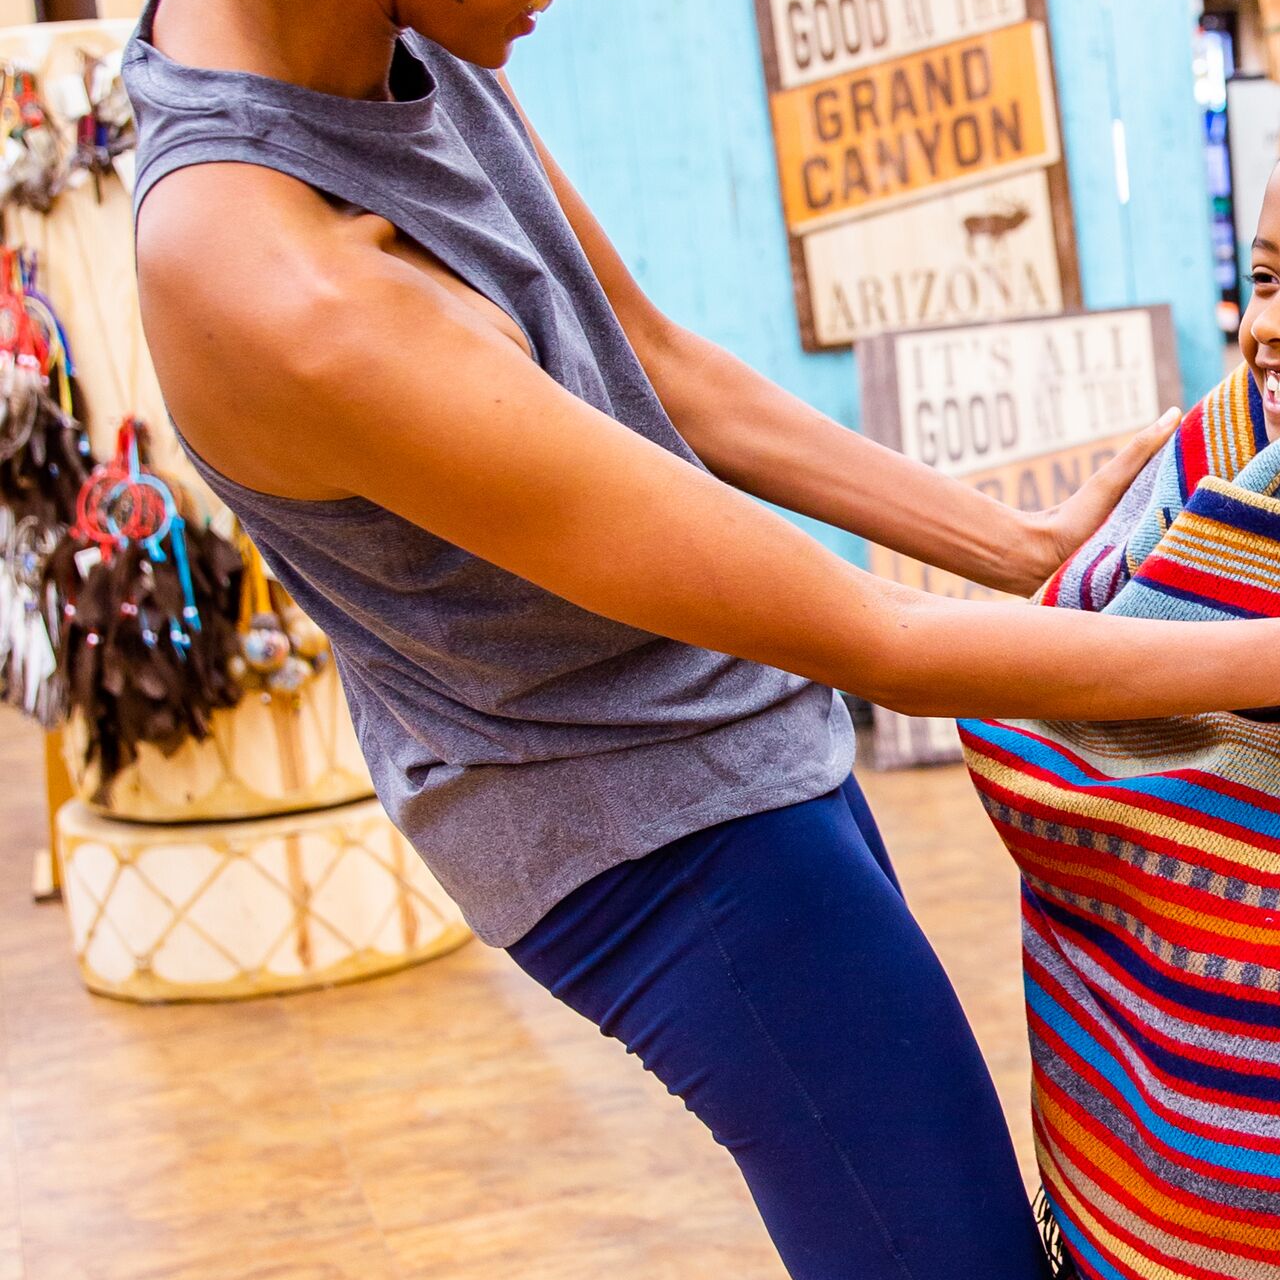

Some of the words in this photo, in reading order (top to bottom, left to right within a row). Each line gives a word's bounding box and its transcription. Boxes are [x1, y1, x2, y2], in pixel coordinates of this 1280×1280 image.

[811, 45, 993, 144] GRAND
[802, 99, 1026, 212] CANYON
[829, 261, 1051, 333] ARIZONA
[911, 339, 1014, 390] IT'S
[1044, 324, 1144, 377] ALL
[914, 392, 1019, 467] GOOD
